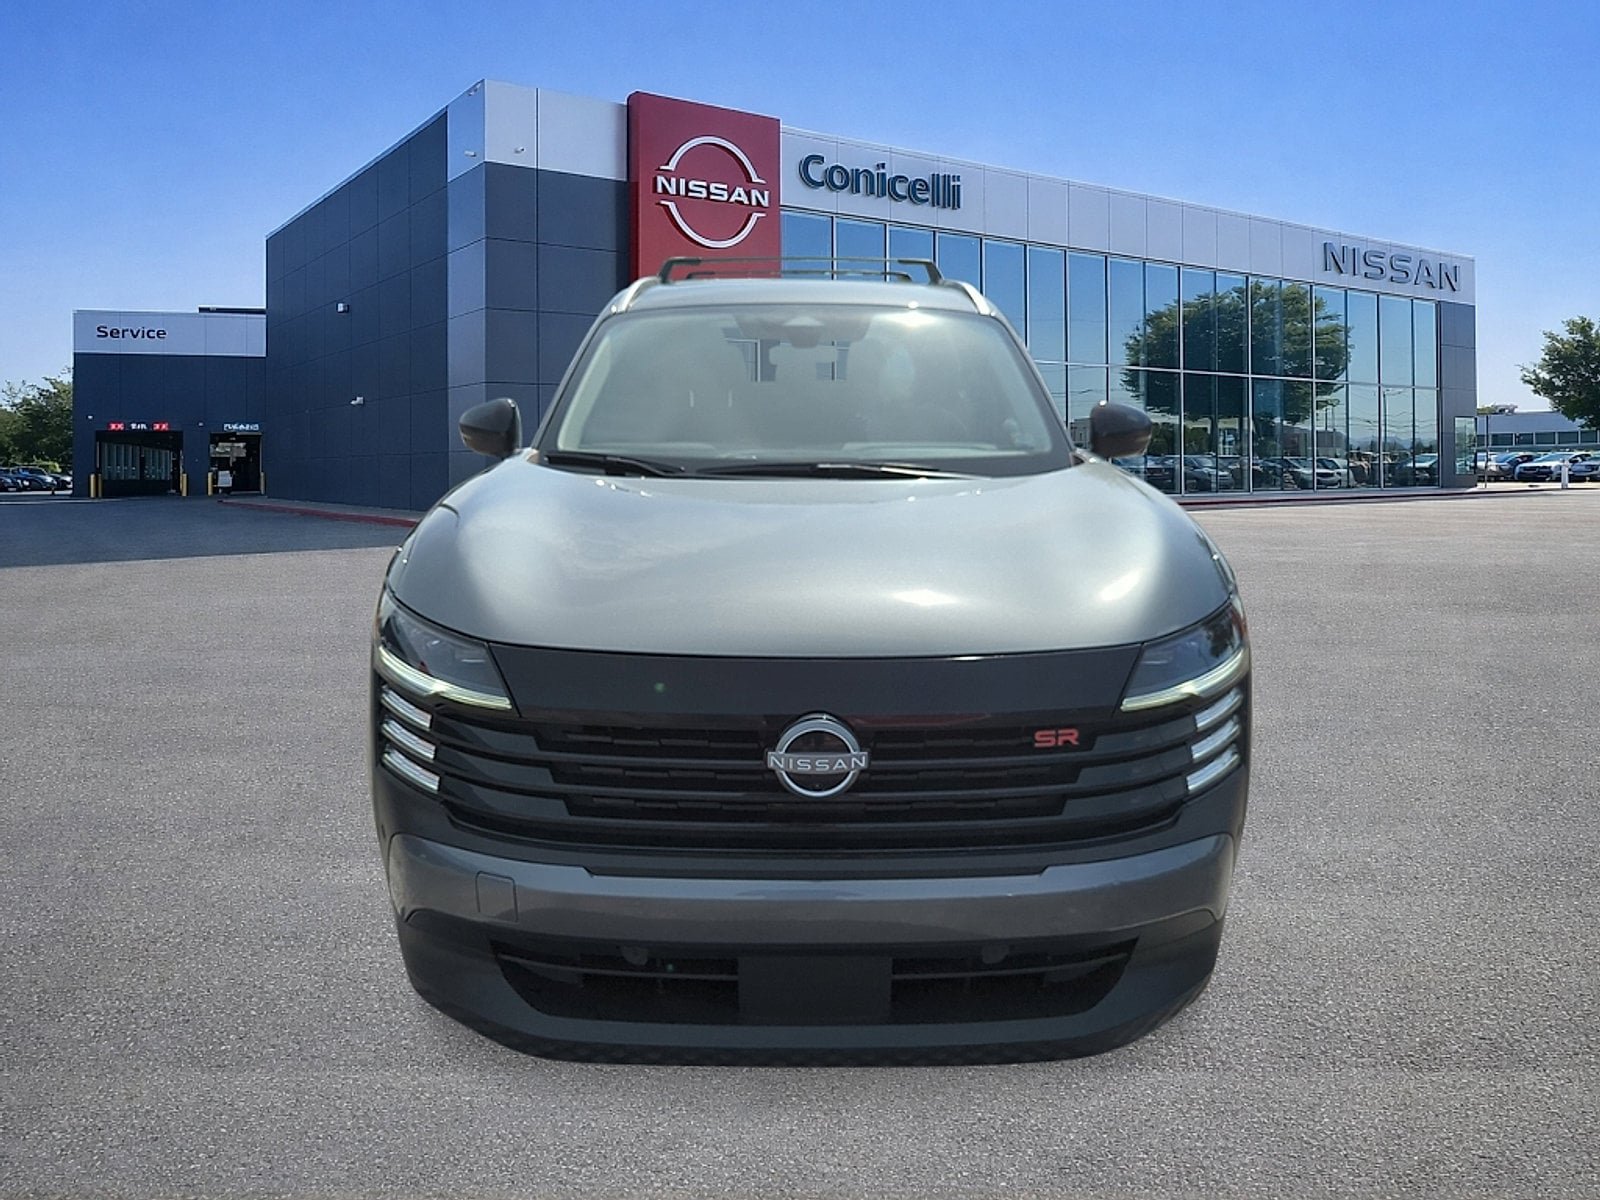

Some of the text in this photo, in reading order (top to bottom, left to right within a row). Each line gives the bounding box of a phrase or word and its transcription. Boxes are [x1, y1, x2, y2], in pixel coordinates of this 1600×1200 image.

[655, 174, 770, 208] NISSAN
[799, 154, 962, 210] Conicelli
[1323, 242, 1461, 292] NISSAN
[96, 325, 168, 339] Service
[1034, 728, 1080, 748] SR
[768, 754, 867, 772] NISSAN
